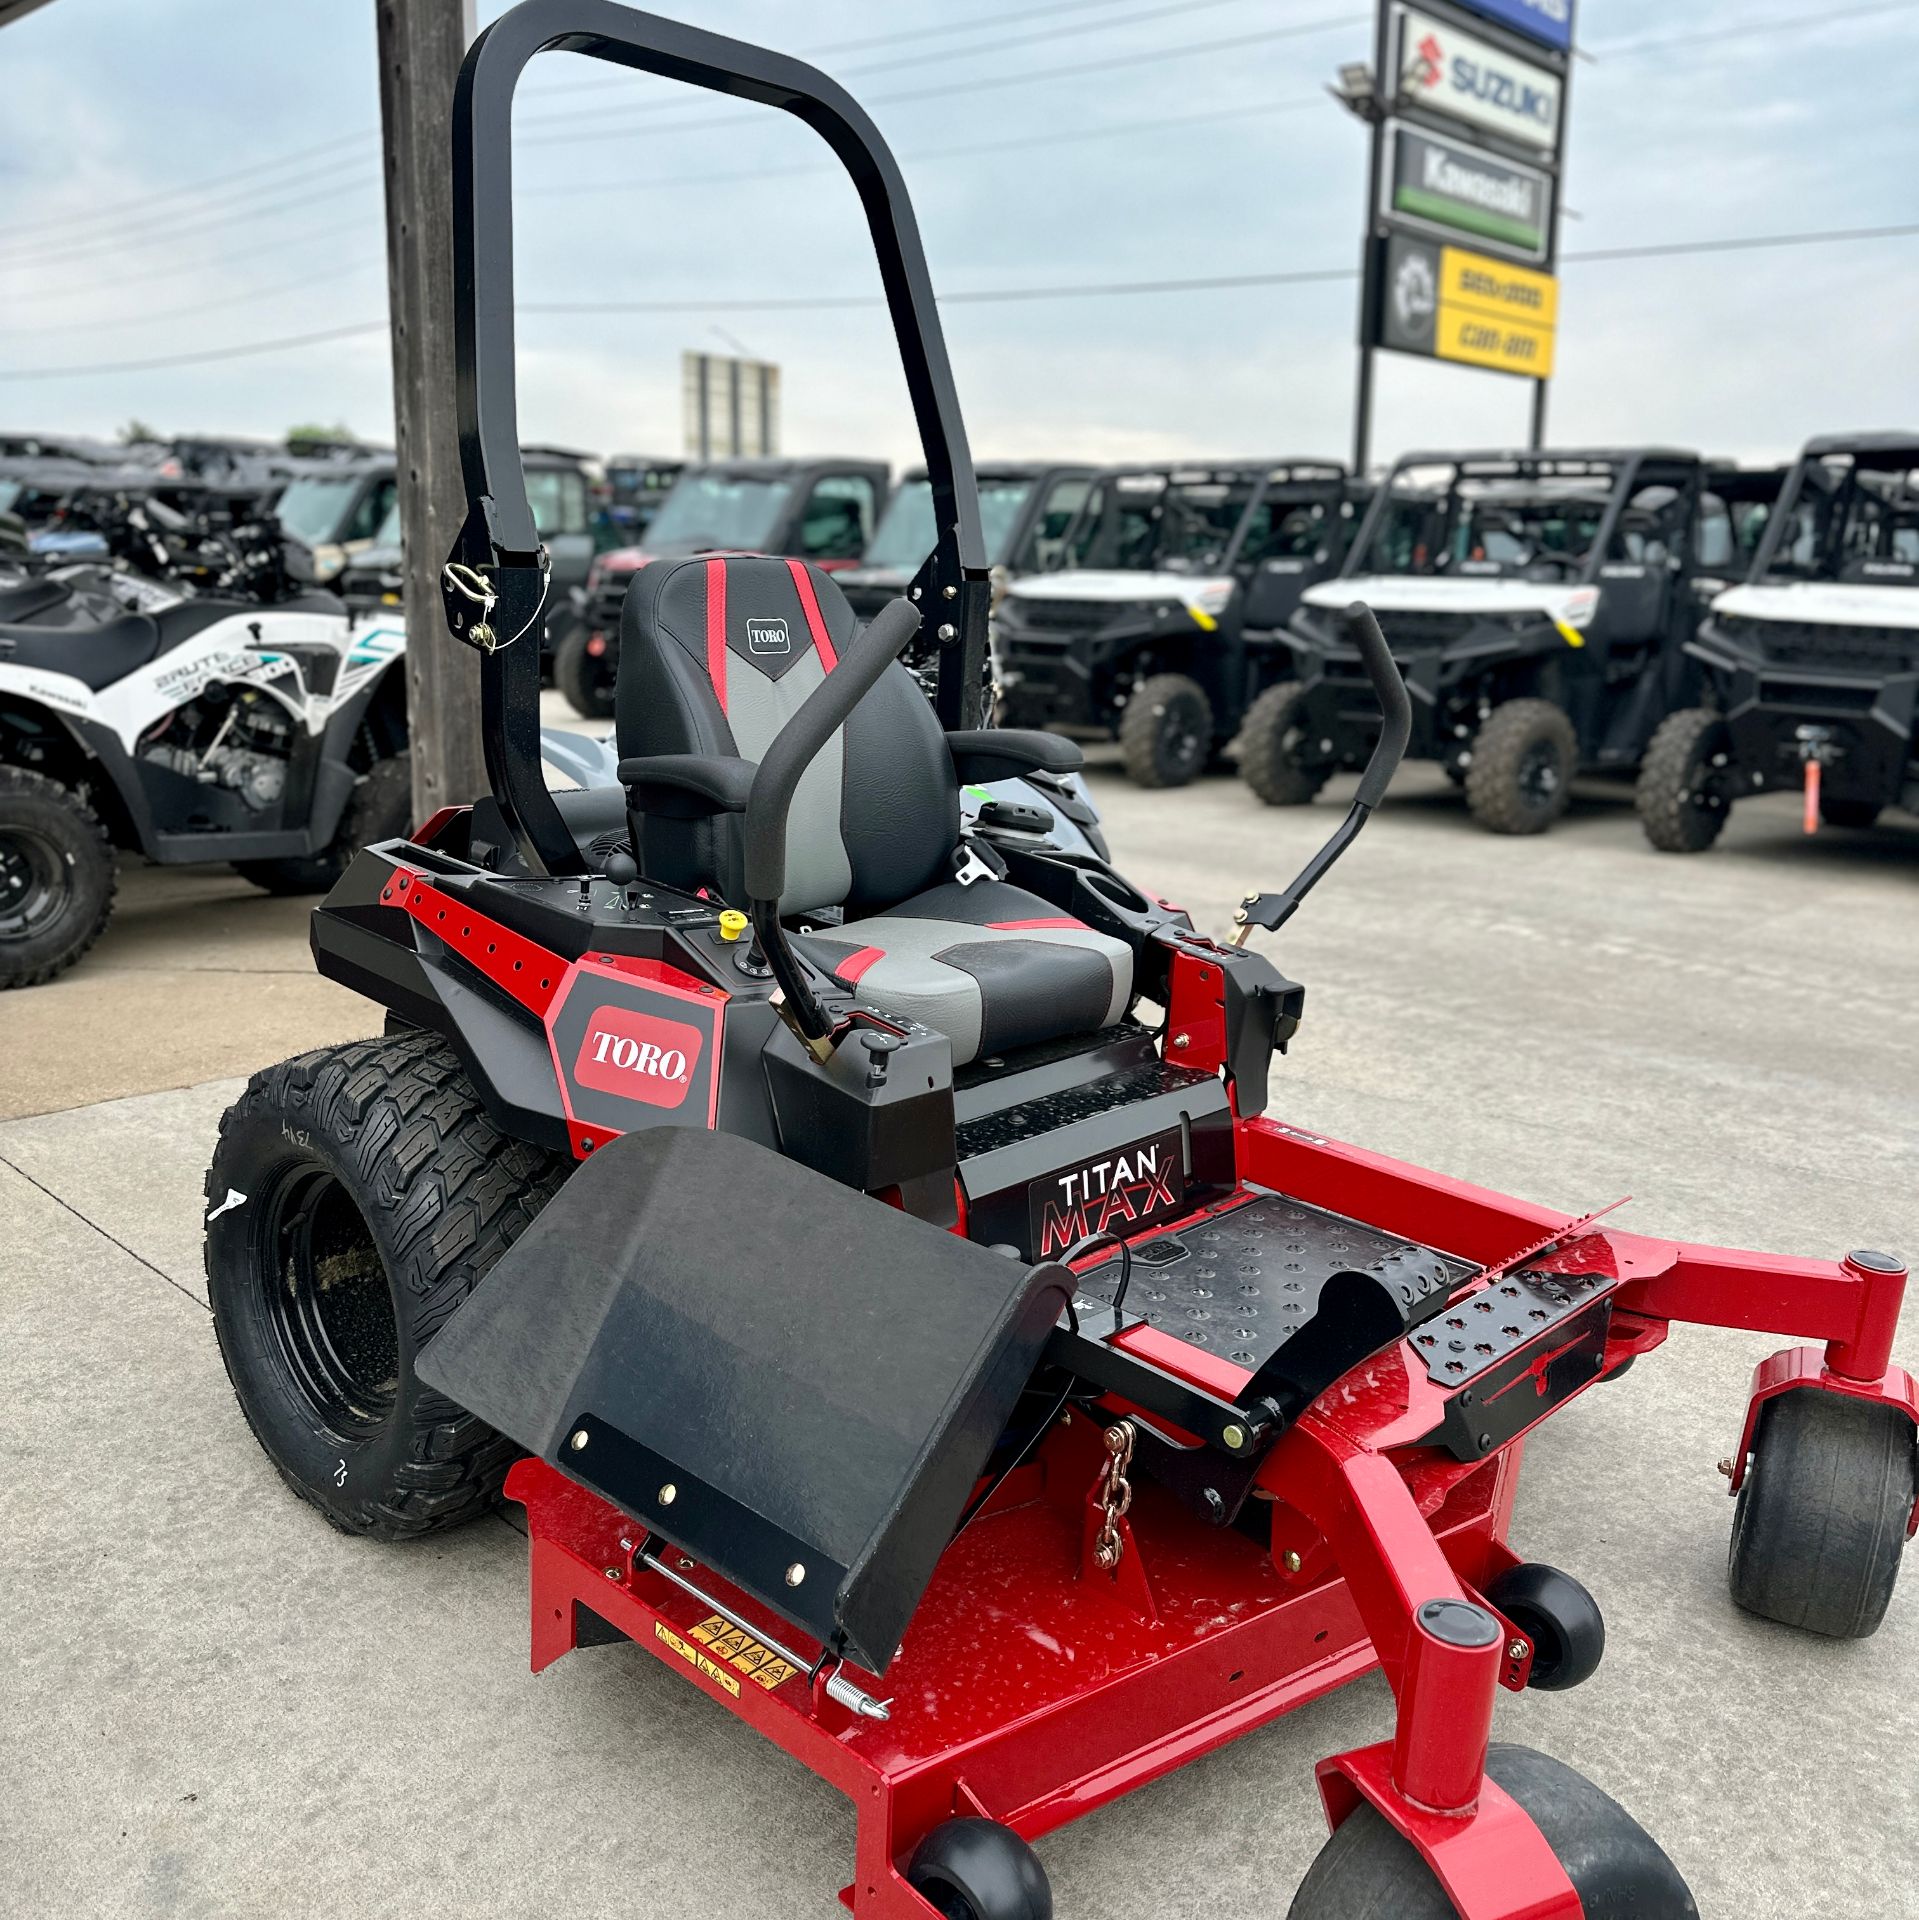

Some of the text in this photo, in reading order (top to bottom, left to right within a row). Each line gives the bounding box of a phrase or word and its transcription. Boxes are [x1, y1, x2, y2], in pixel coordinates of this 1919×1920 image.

[750, 629, 786, 643] TORO
[592, 1031, 687, 1081] TORO
[1058, 1145, 1158, 1207] TITAN
[1040, 1154, 1177, 1257] MAX
